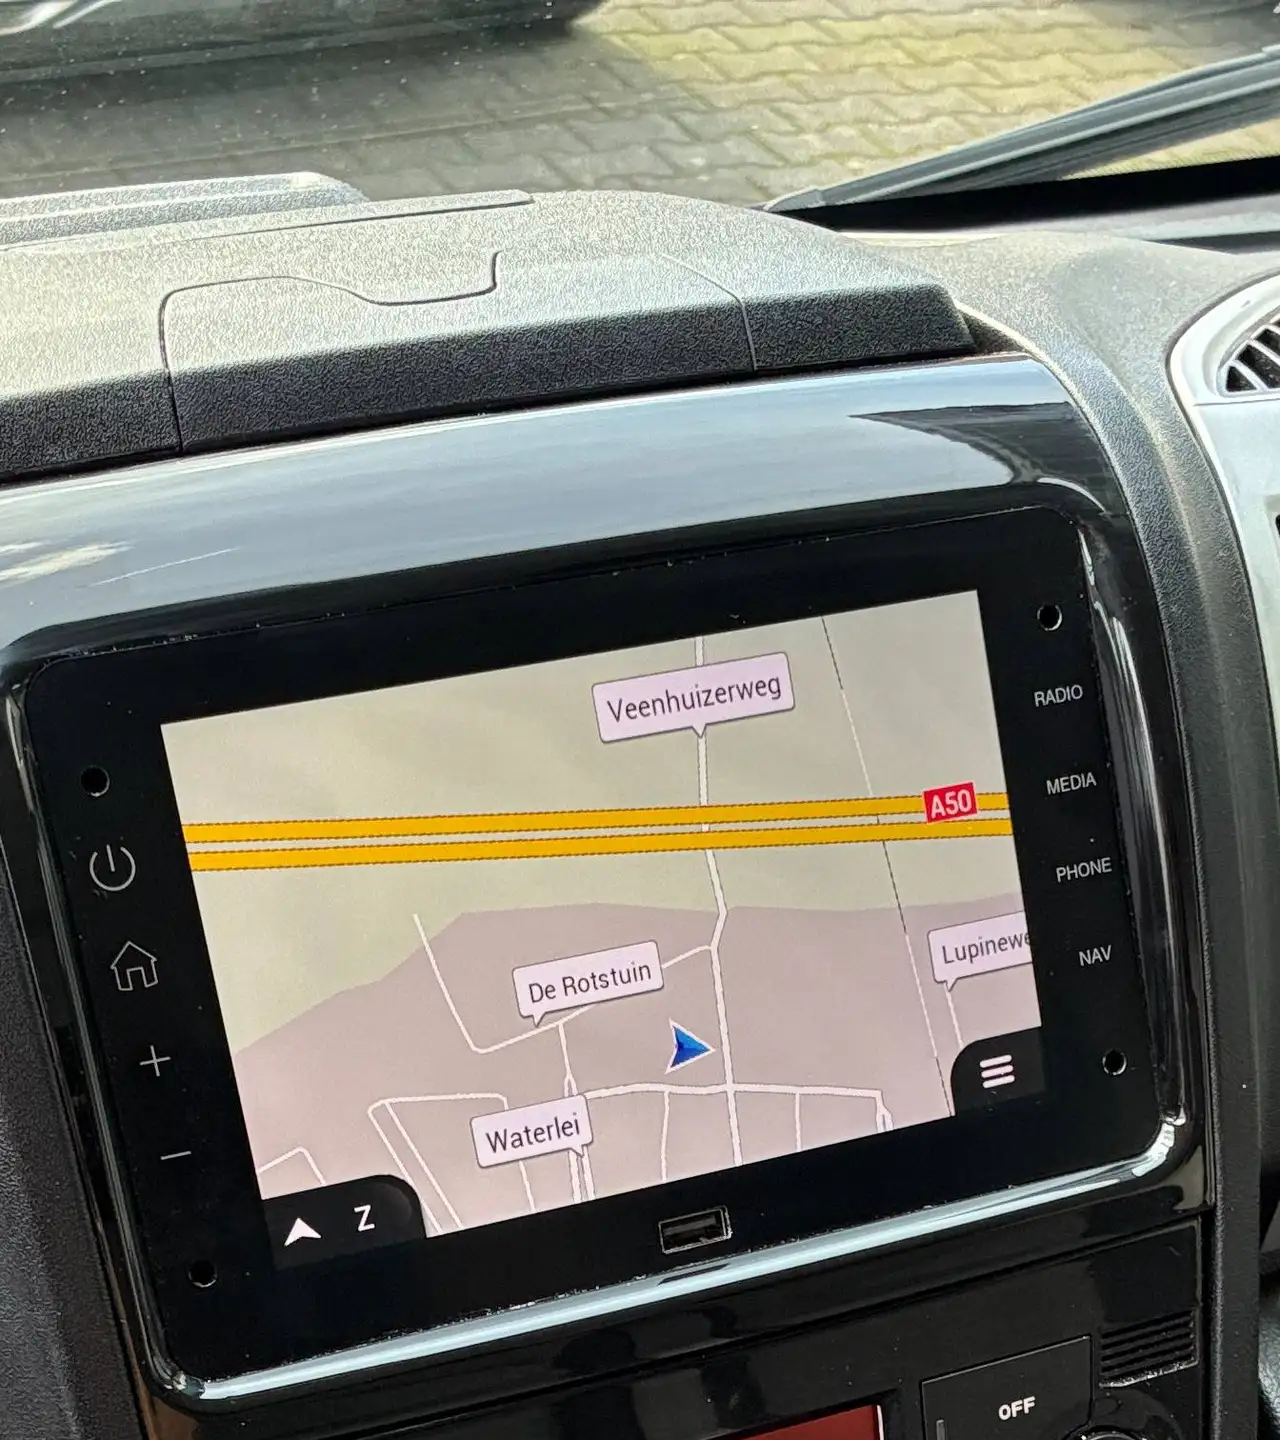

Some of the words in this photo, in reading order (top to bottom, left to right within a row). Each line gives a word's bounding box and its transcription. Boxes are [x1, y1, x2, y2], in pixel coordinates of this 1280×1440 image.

[607, 676, 782, 723] Veenhuizerweg
[1034, 684, 1083, 707] RADIO
[1046, 772, 1097, 795] MEDIA
[931, 789, 973, 819] A50
[1056, 857, 1112, 882] PHONE
[1078, 944, 1112, 966] NAV
[528, 981, 556, 1004] De
[562, 960, 652, 996] Rotstuin
[486, 1113, 581, 1154] Waterlei
[353, 1204, 376, 1232] Z
[998, 1396, 1036, 1421] OFF
